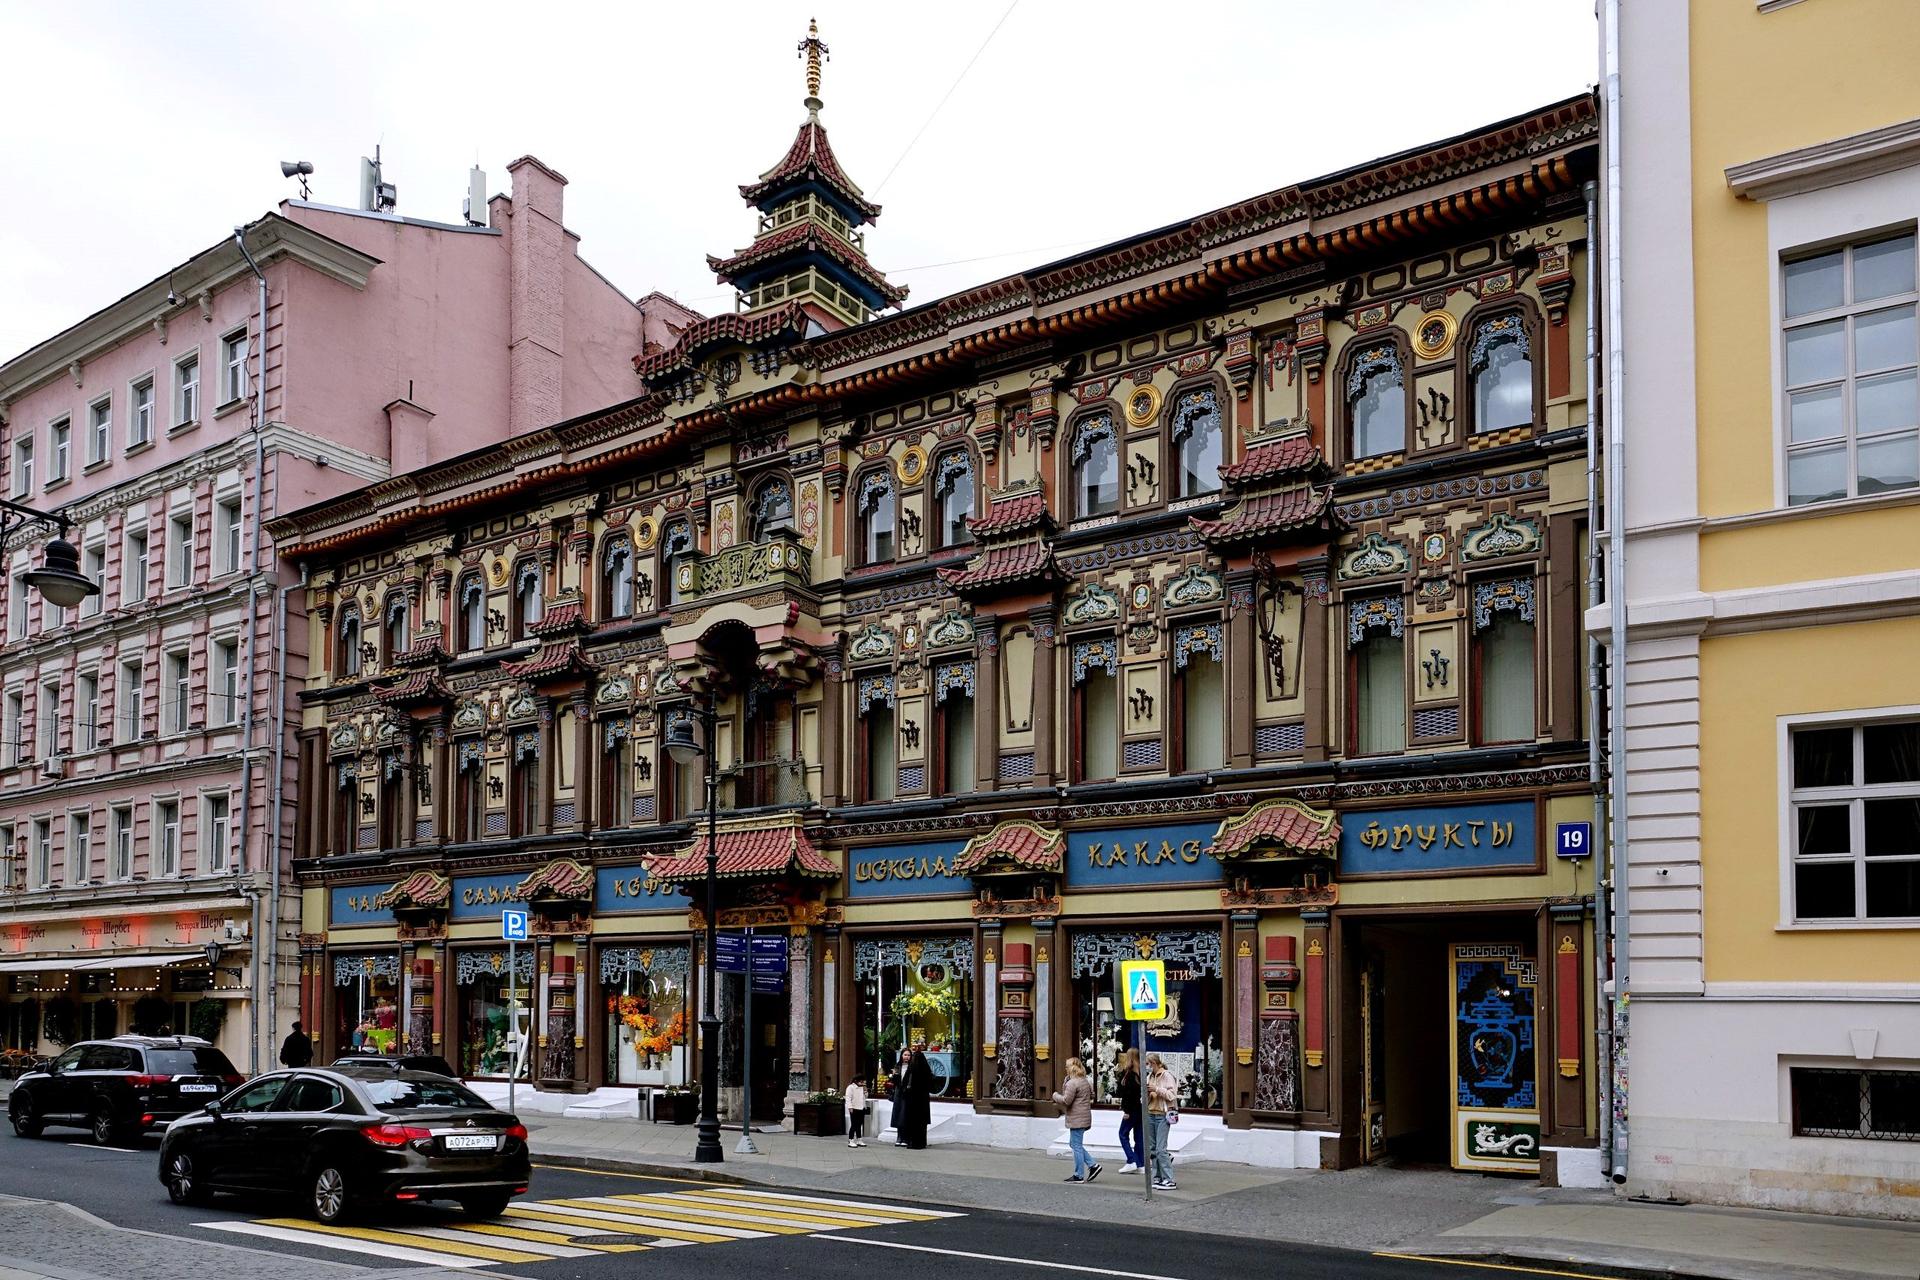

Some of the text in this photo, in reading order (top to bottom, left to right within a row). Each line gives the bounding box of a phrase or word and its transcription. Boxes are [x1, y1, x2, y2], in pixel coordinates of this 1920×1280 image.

[1360, 820, 1514, 850] ФРУКТЫ
[1562, 830, 1583, 848] 19
[1088, 840, 1201, 868] КАКАО
[463, 885, 519, 906] САХА
[103, 919, 130, 937] Шербет
[200, 913, 231, 932] Шерб
[508, 913, 522, 936] P
[1165, 969, 1199, 981] СТИЯ
